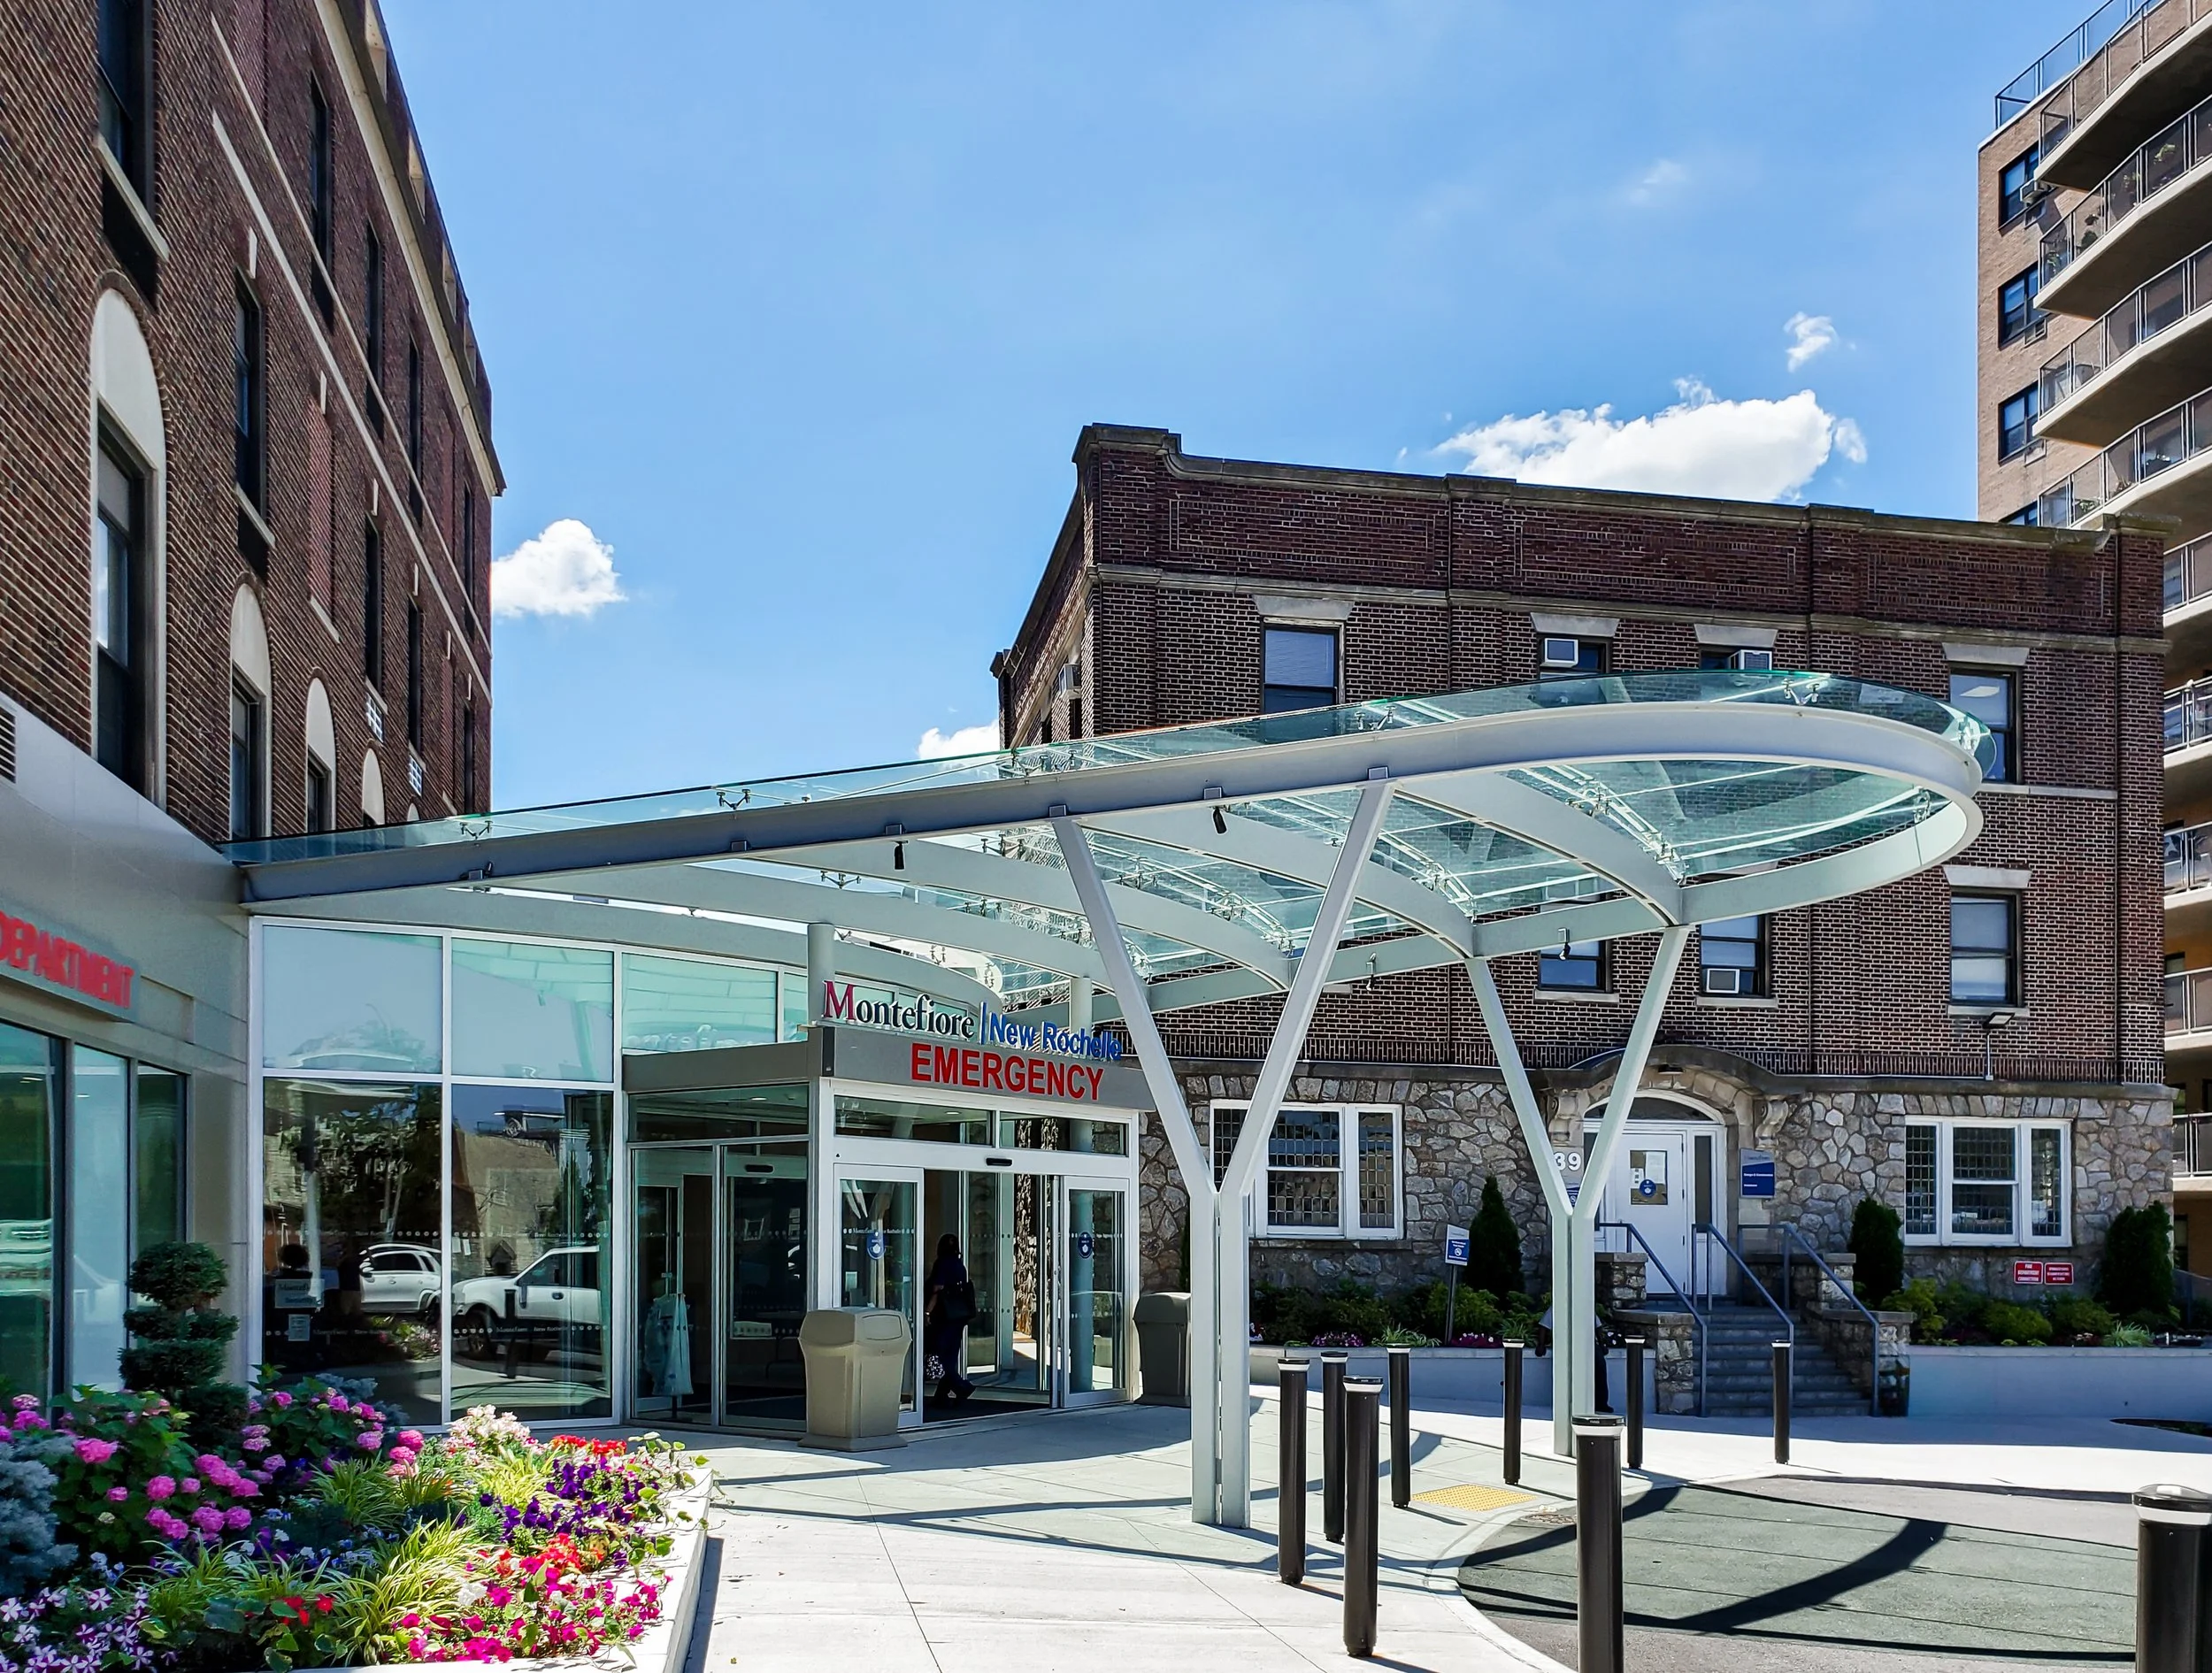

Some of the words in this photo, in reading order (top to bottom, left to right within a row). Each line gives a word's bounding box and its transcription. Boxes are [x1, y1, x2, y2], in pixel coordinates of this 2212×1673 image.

[824, 980, 974, 1038] Montefiore
[988, 1012, 1037, 1049] New
[1042, 1021, 1123, 1062] Rochelle
[910, 1042, 1104, 1101] EMERGENCY
